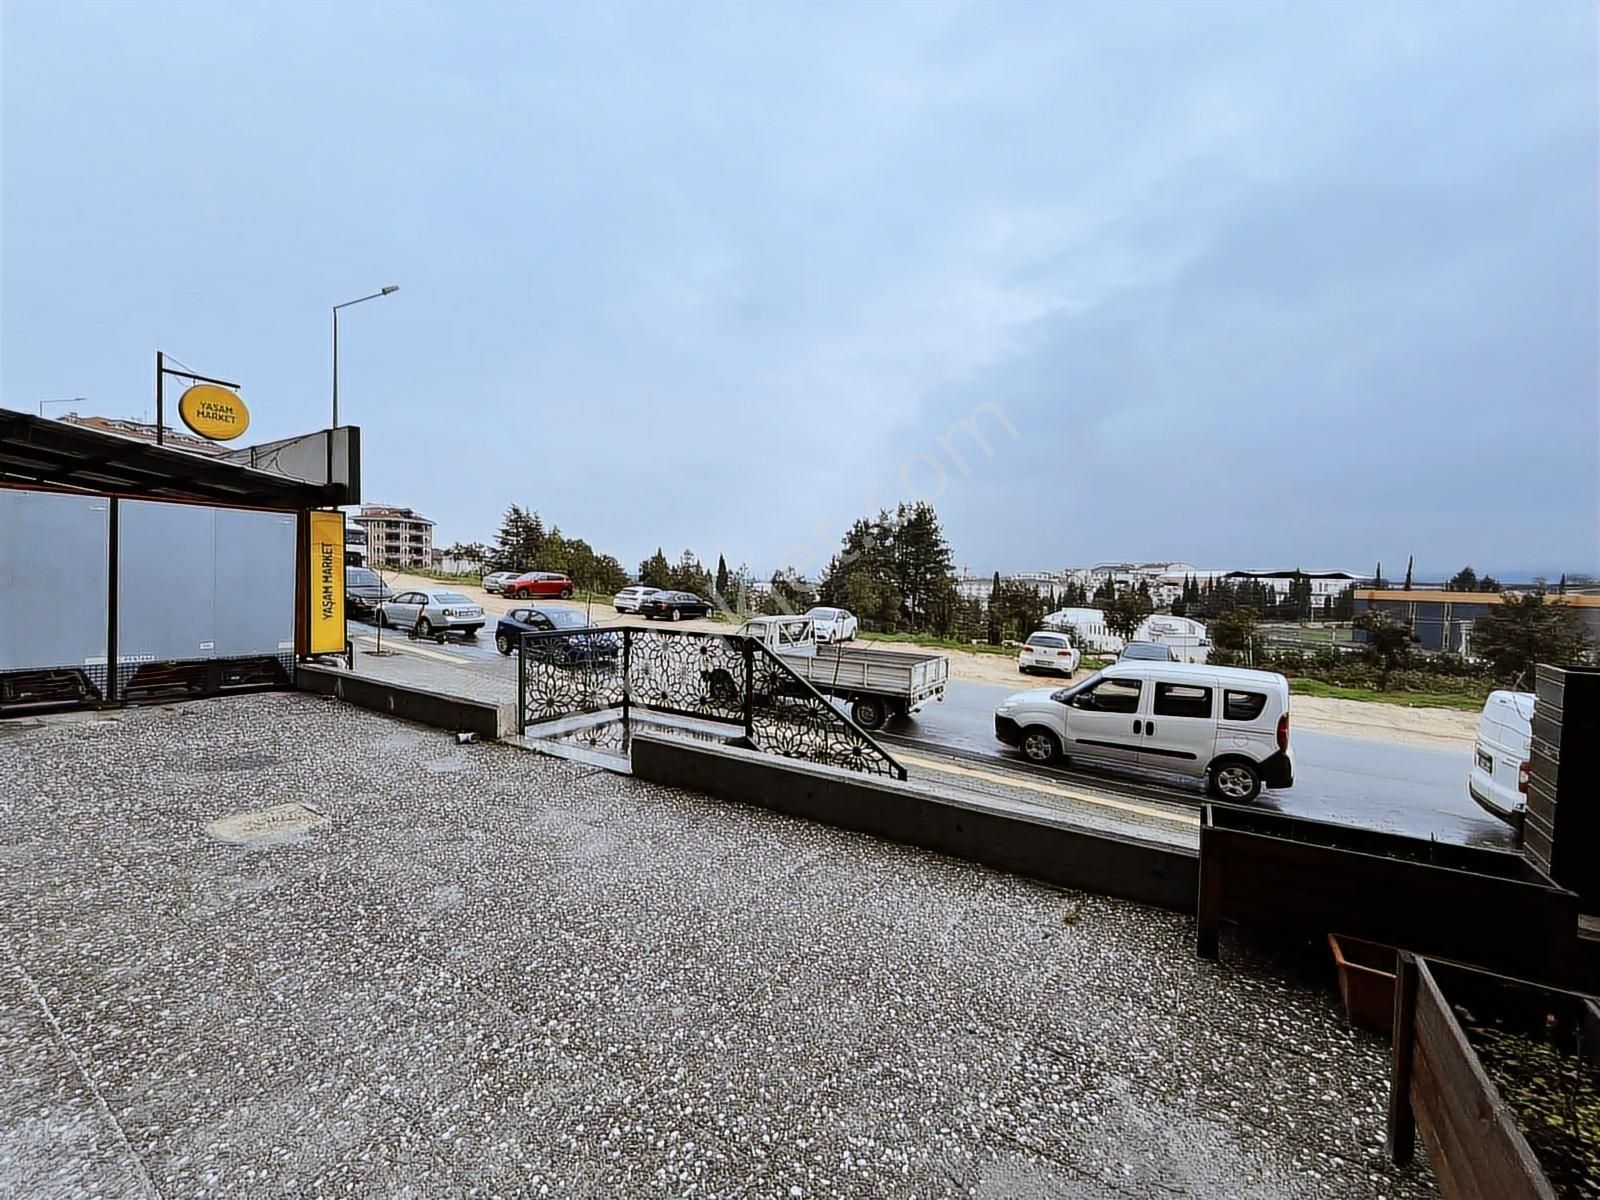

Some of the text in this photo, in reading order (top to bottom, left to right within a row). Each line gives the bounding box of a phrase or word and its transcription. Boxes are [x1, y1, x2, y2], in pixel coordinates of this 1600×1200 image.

[196, 409, 236, 424] MARKET
[322, 542, 336, 620] YAŞAM MARKET
